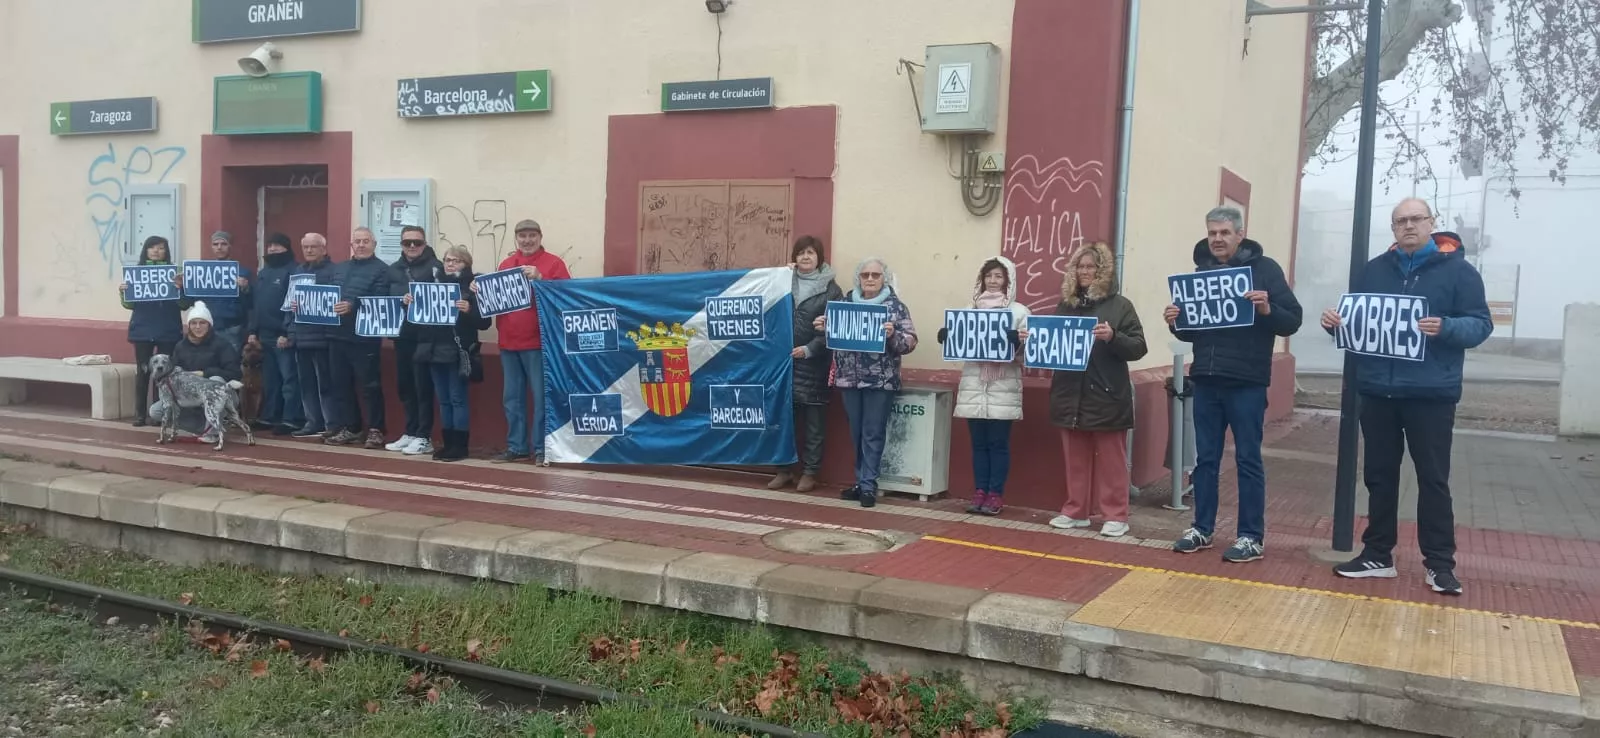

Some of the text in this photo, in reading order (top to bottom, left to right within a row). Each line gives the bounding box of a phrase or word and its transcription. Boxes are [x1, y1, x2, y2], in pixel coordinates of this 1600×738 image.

[424, 87, 487, 104] Barcelona
[671, 87, 766, 101] Gabinete de Circulación
[90, 110, 132, 125] Zaragoza
[124, 268, 176, 284] ALBERO
[185, 265, 237, 289] PIRACES
[133, 283, 169, 299] BAJO
[1172, 273, 1249, 303] ALBERO
[295, 290, 339, 318] TRAMACED
[413, 284, 456, 323] CURBE
[707, 298, 760, 317] QUEREMOS
[1184, 298, 1238, 326] BAJO
[709, 318, 760, 337] TRENES
[826, 308, 886, 342] ALMUNIENTE
[1339, 295, 1424, 358] ROBRES
[946, 311, 1009, 360] ROBRES
[591, 397, 598, 413] A
[734, 388, 741, 404] Y
[575, 412, 618, 432] LÉRIDA
[712, 407, 764, 424] BARCELONA
